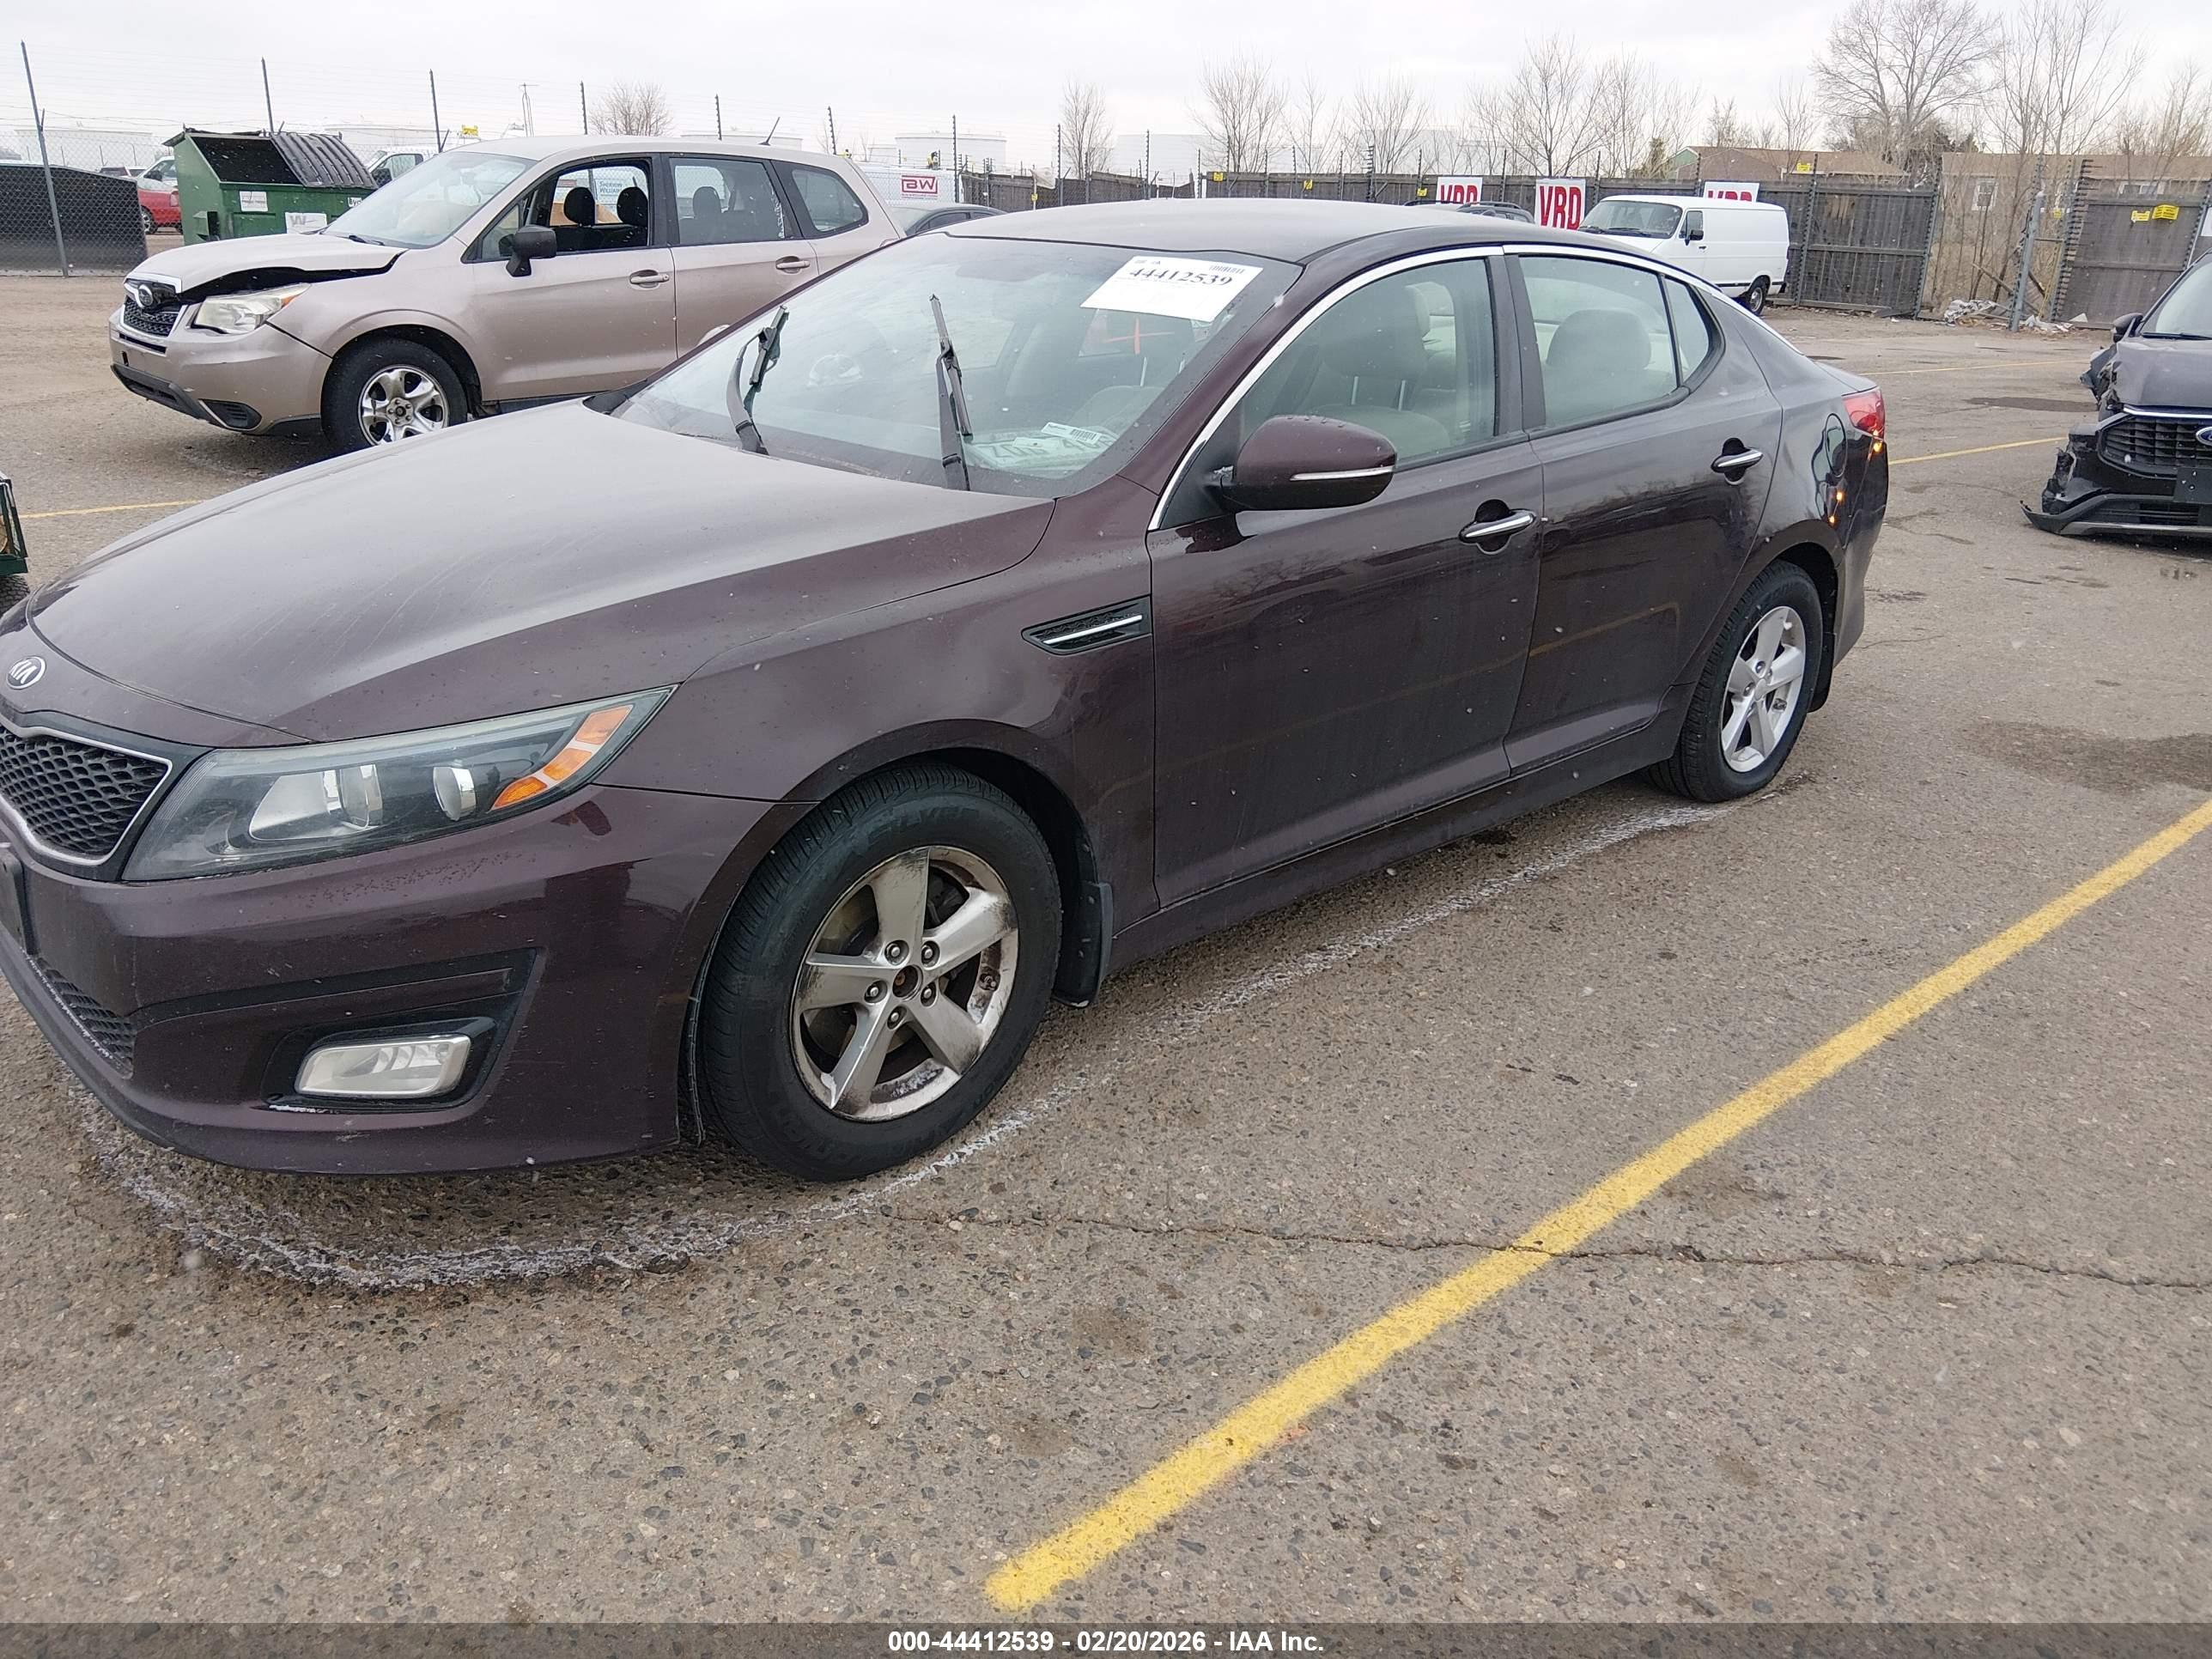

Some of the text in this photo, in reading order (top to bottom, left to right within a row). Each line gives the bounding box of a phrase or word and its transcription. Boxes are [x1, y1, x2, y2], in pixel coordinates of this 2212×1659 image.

[902, 176, 937, 192] BW
[1540, 185, 1582, 230] VRD
[1129, 267, 1233, 286] 44412539
